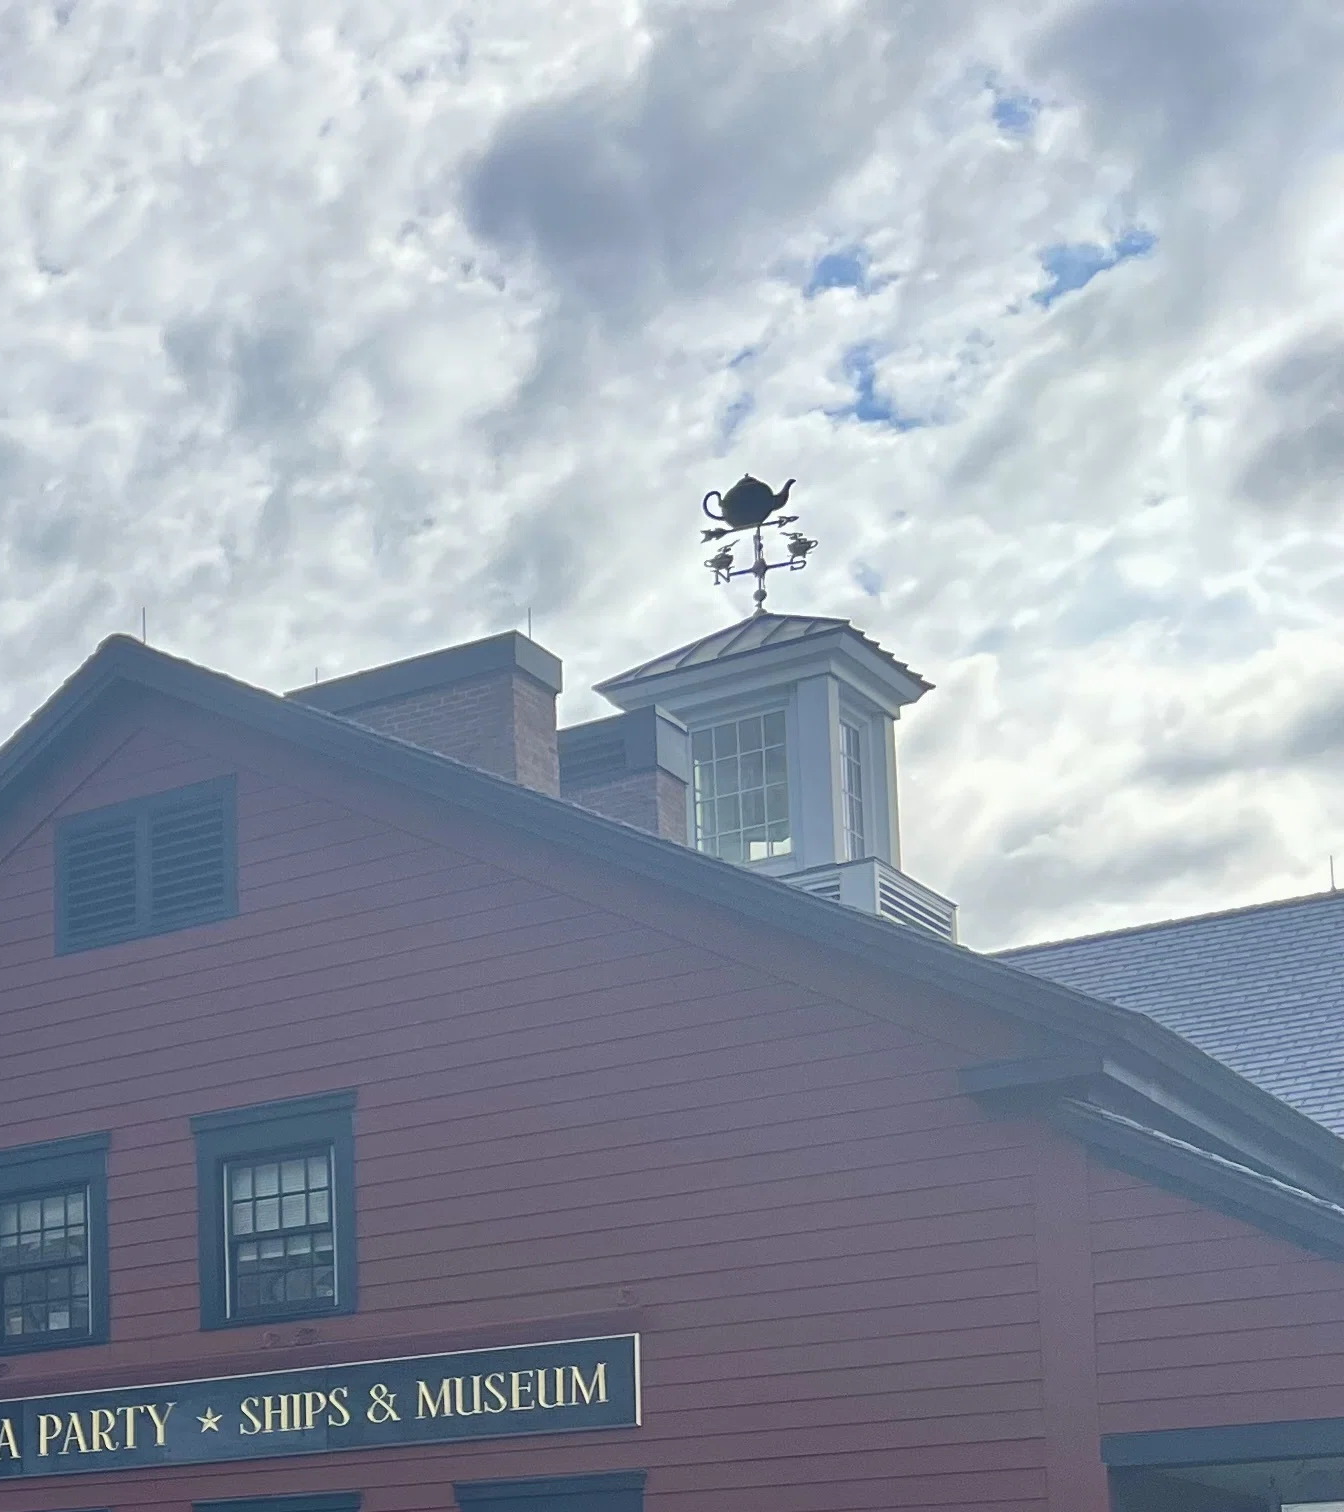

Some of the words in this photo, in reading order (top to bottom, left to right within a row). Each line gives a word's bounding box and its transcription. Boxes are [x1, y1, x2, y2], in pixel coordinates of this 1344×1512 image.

[36, 1401, 178, 1458] PARTY
[238, 1384, 352, 1436] SHIPS
[366, 1383, 402, 1424] &
[413, 1361, 611, 1421] MUSEUM
